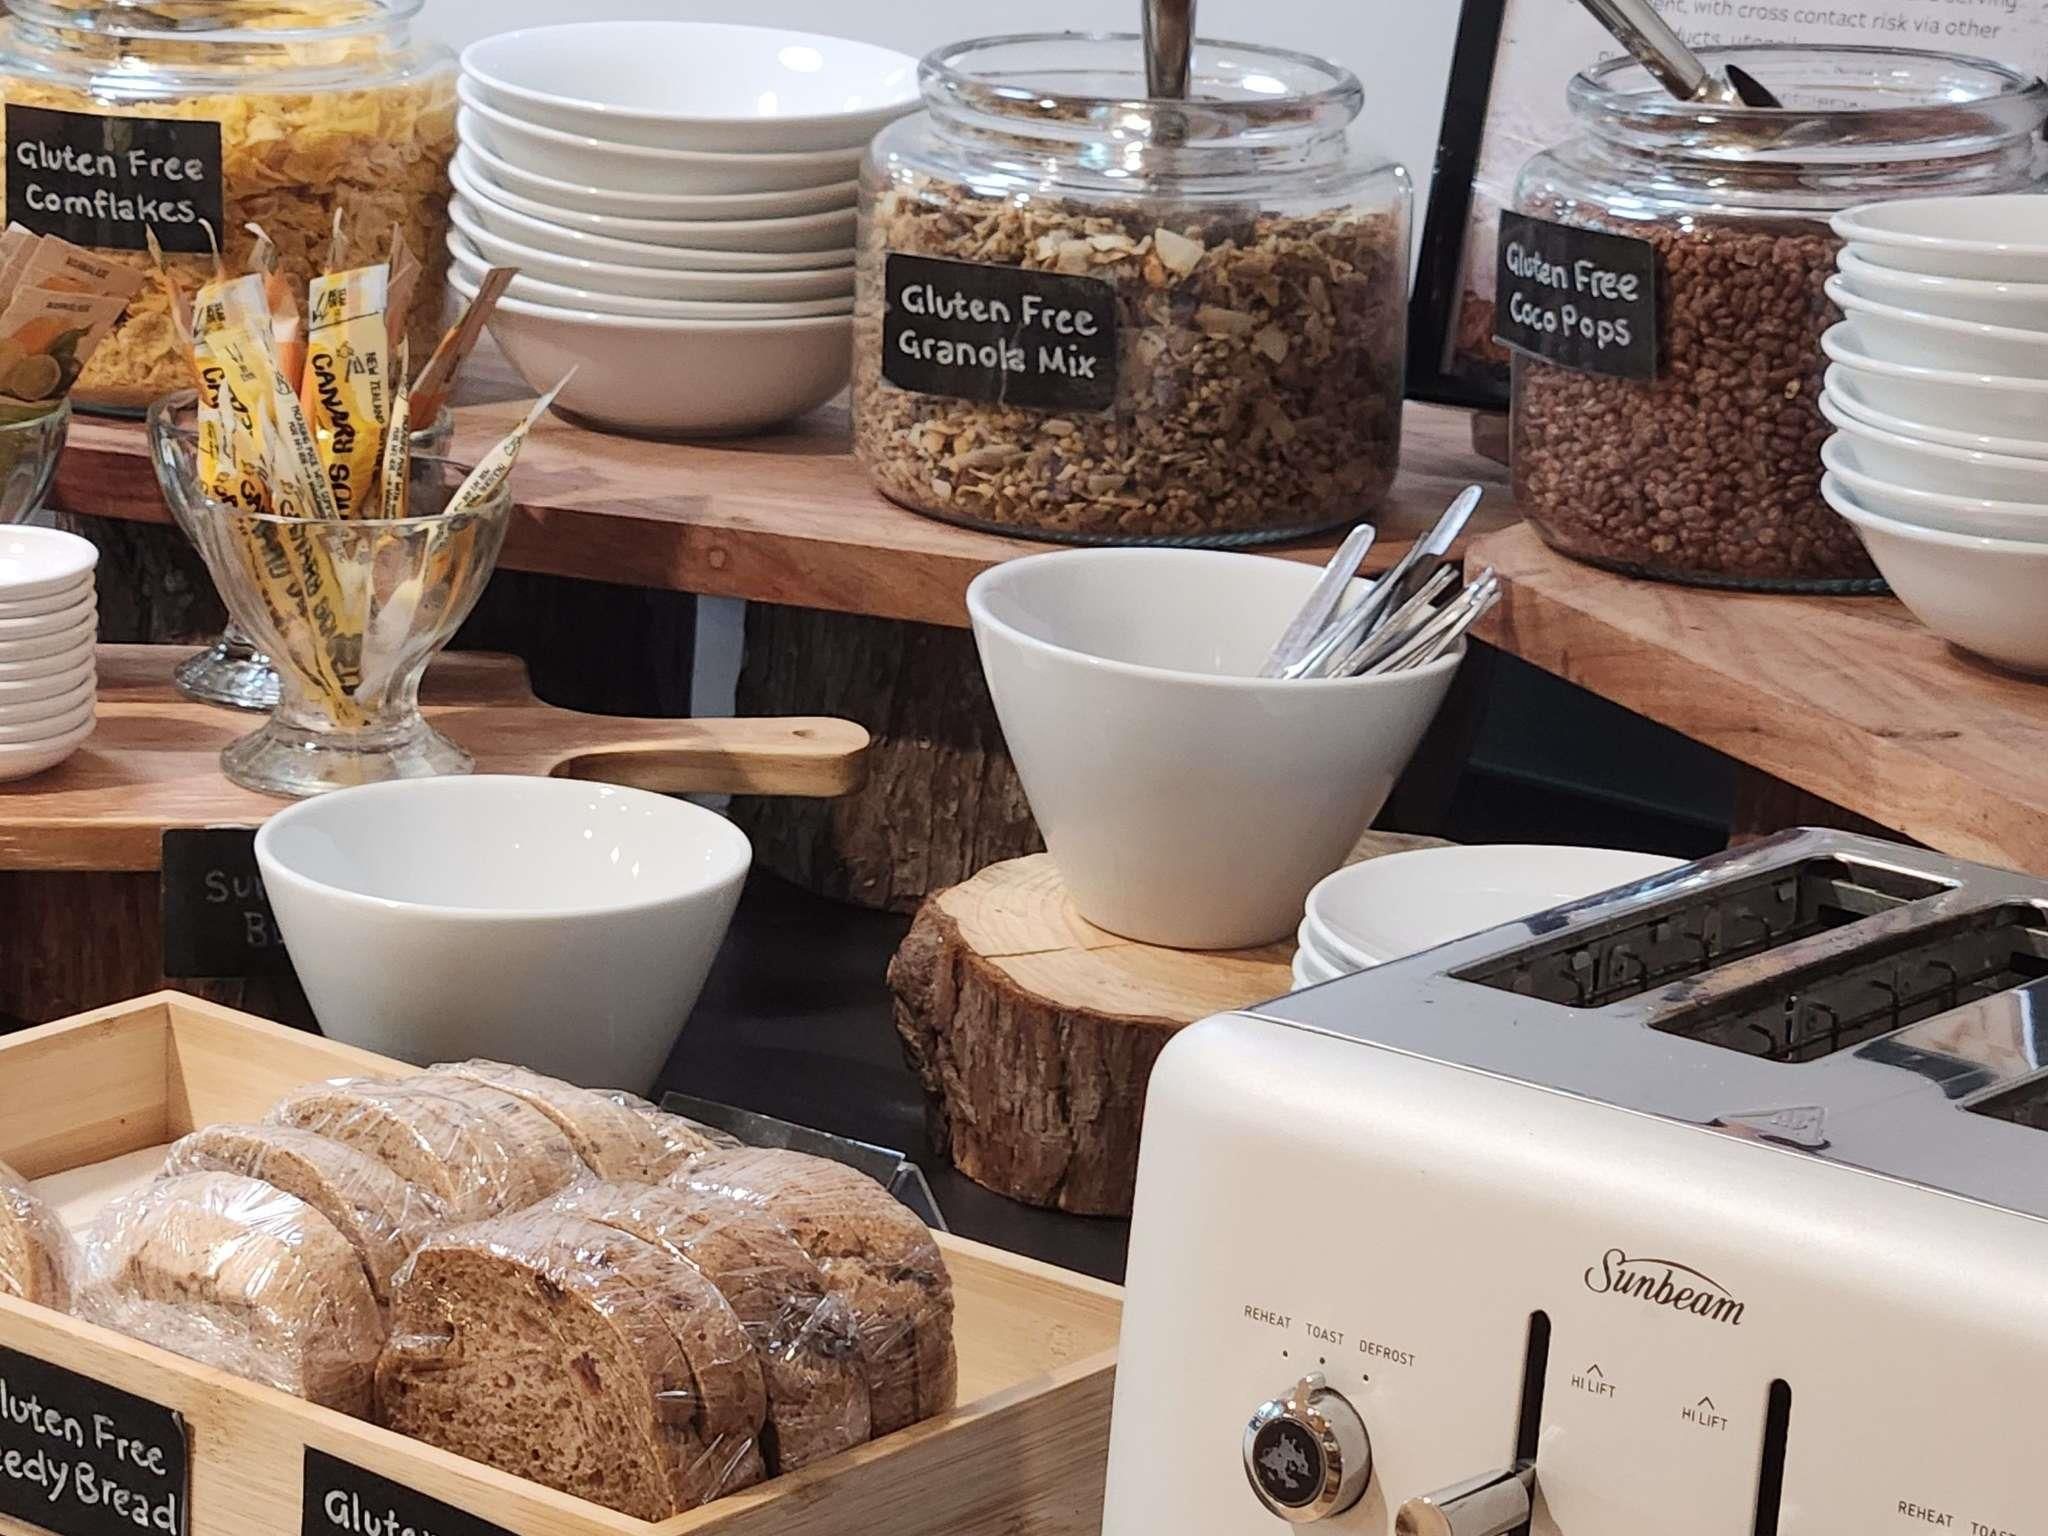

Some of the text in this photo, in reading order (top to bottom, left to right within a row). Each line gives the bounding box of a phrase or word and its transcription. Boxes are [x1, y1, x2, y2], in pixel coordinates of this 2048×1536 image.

[1737, 6, 1789, 23] cross
[1793, 10, 1867, 28] contact
[1871, 13, 1909, 32] risk
[1913, 17, 1940, 35] via
[1944, 18, 2002, 39] other
[16, 140, 204, 181] Gluten Free
[1506, 241, 1639, 301] Gluten Free
[901, 284, 1098, 336] Gluten Free
[898, 329, 1097, 379] Granola Mix
[1584, 1248, 1744, 1325] Sunbeam
[1243, 1304, 1416, 1368] REHEAT TOAST DEFROST
[0, 1378, 167, 1476] luten Free
[0, 1449, 177, 1536] edy Bread
[324, 1489, 440, 1536] Glut
[1898, 1500, 1954, 1528] REHEAT
